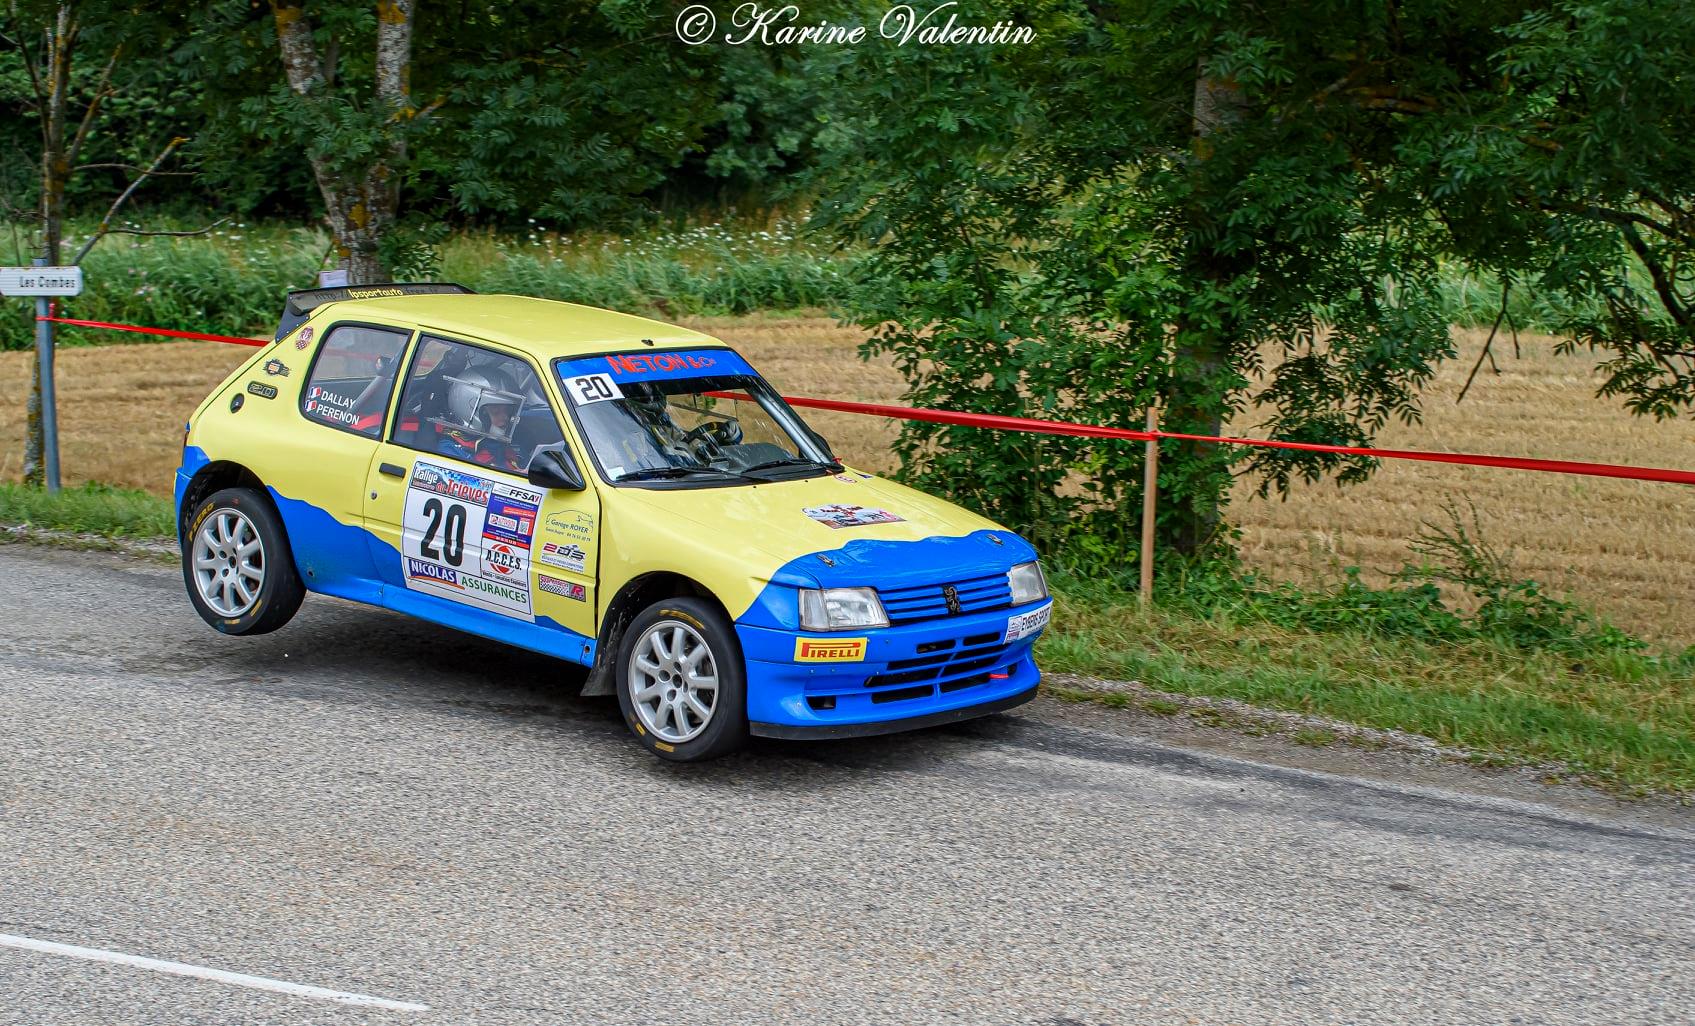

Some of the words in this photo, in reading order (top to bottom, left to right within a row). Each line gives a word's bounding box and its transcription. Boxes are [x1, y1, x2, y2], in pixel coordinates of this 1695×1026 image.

[20, 276, 34, 288] Les
[39, 276, 75, 288] Combes
[605, 354, 689, 375] NETON
[575, 376, 613, 401] 20
[321, 390, 356, 409] DALLAY
[316, 404, 359, 426] PERENON
[414, 468, 438, 485] Rallye
[509, 489, 536, 501] FFSA
[420, 497, 467, 567] 20
[551, 519, 569, 529] Garage
[411, 559, 455, 584] NICOLAS
[461, 575, 527, 604] ASSURANCES
[801, 642, 861, 658] PIRELLI
